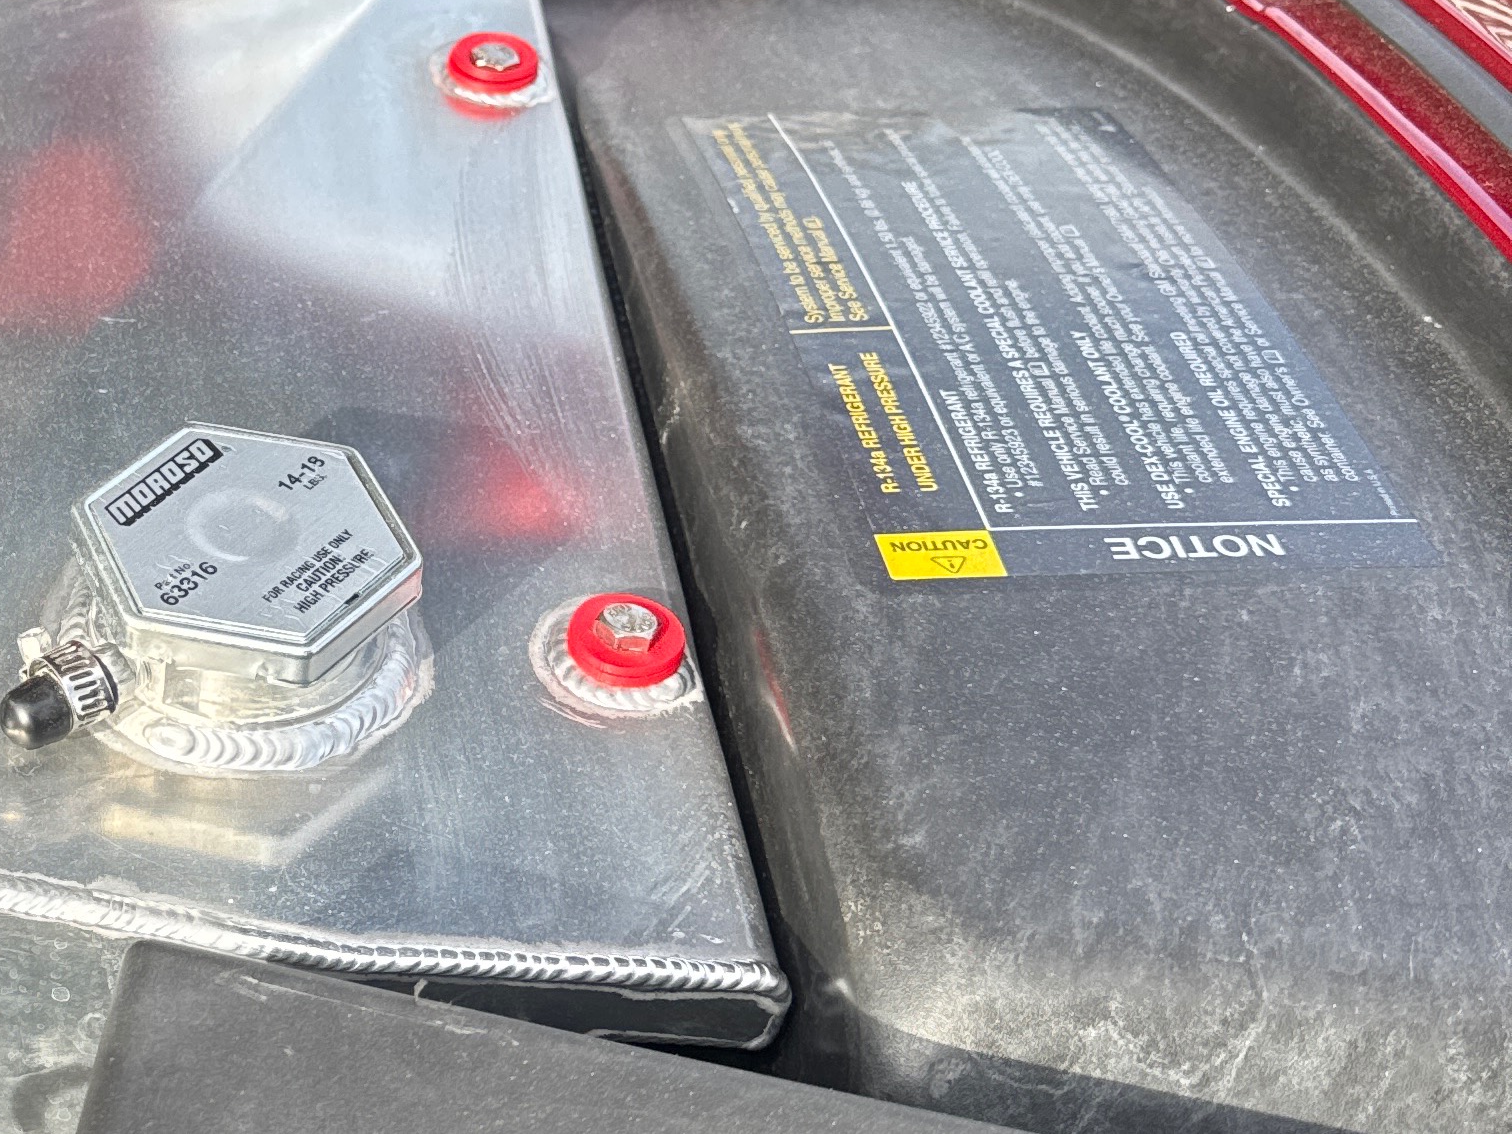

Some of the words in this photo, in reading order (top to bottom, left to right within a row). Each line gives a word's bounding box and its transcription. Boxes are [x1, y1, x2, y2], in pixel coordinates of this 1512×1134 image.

[761, 223, 793, 259] serviced
[806, 230, 839, 261] Manual
[931, 231, 968, 267] SERVICE
[779, 261, 800, 272] be
[793, 245, 825, 276] service
[885, 249, 927, 289] equivalent
[785, 275, 805, 284] to
[823, 263, 859, 298] Service
[920, 274, 940, 285] be
[928, 288, 948, 299] will
[954, 269, 996, 313] COOLANT
[1000, 278, 1035, 308] engine.
[1052, 274, 1089, 302] Adding
[1153, 280, 1179, 295] GM
[788, 286, 828, 322] System
[809, 279, 851, 321] Improper
[842, 300, 871, 320] See
[911, 291, 929, 300] or
[986, 288, 1010, 304] and
[1079, 283, 1114, 314] sooner.
[1190, 305, 1214, 315] by
[1193, 286, 1238, 326] American
[912, 302, 956, 349] #12345922
[936, 302, 971, 332] system
[997, 306, 1024, 326] flush
[1017, 310, 1041, 324] the
[1110, 303, 1139, 321] your
[1165, 297, 1206, 330] meeting
[1225, 302, 1264, 334] Service
[980, 316, 1021, 358] SPECIAL
[1009, 329, 1041, 357] before
[1026, 326, 1047, 335] to
[1100, 316, 1131, 340] much
[1123, 323, 1151, 341] See
[1187, 332, 1210, 343] oil
[1197, 317, 1238, 353] covered
[1223, 327, 1249, 342] the
[1252, 337, 1271, 346] or
[963, 352, 981, 360] or
[1032, 337, 1074, 374] damage
[1068, 330, 1101, 358] ONLY
[1094, 340, 1117, 353] life
[1115, 342, 1158, 376] change
[1165, 331, 1220, 385] REQUIRED
[1236, 344, 1266, 366] have
[938, 352, 986, 399] refrigerant
[1102, 355, 1147, 399] extended
[1135, 345, 1174, 380] coolant.
[1195, 346, 1236, 378] special
[1223, 355, 1247, 369] not
[857, 352, 906, 412] PRESSURE
[965, 363, 1014, 412] equivalent
[1054, 376, 1092, 411] serious
[1084, 360, 1135, 413] COOLANT
[1233, 372, 1280, 411] damage
[1252, 369, 1281, 388] also
[1268, 366, 1313, 405] Owner's
[825, 363, 886, 447] REFRIGERANT
[1008, 370, 1059, 426] REQUIRES
[1033, 378, 1072, 413] Manual
[1129, 402, 1157, 419] has
[1136, 379, 1184, 421] requiring
[1158, 382, 1199, 414] engine
[1202, 388, 1232, 406] OIL
[1217, 380, 1266, 419] requires
[1266, 390, 1298, 415] must
[887, 415, 919, 444] HIGH
[935, 389, 998, 469] REFRIGERANT
[964, 402, 1002, 439] R-134a
[994, 415, 1016, 426] or
[1075, 413, 1096, 422] in
[1178, 417, 1205, 432] life
[1213, 409, 1262, 452] ENGINE
[1259, 413, 1303, 447] engine
[1297, 408, 1327, 427] See
[1054, 416, 1094, 454] Service
[1081, 425, 1114, 453] result
[1140, 422, 1180, 458] vehicle
[1245, 422, 1290, 456] engine
[985, 442, 1016, 463] only
[998, 428, 1049, 486] #12345923
[1039, 430, 1087, 479] VEHICLE
[1175, 444, 1217, 482] coolant
[1189, 434, 1238, 482] extended
[1283, 451, 1320, 481] cause
[1311, 432, 1364, 480] container.
[105, 438, 223, 526] MOROSO
[863, 450, 903, 492] R-134a
[900, 447, 941, 490] UNDER
[996, 466, 1025, 487] Use
[1077, 457, 1110, 484] Read
[1098, 456, 1132, 485] could
[1162, 461, 1194, 483] This
[1241, 455, 1296, 506] SPECIAL
[1266, 459, 1300, 481] This
[1317, 468, 1340, 480] as
[977, 472, 1017, 512] R-134a
[1068, 482, 1102, 510] THIS
[1154, 483, 1187, 508] USE
[887, 538, 990, 551] CAUTION
[1101, 532, 1287, 559] NOTICE
[261, 585, 286, 604] FOR
[279, 560, 316, 588] RACING
[310, 546, 334, 563] USE
[328, 528, 354, 549] ONLY
[160, 561, 218, 606] 63316
[293, 589, 325, 614] HIGH
